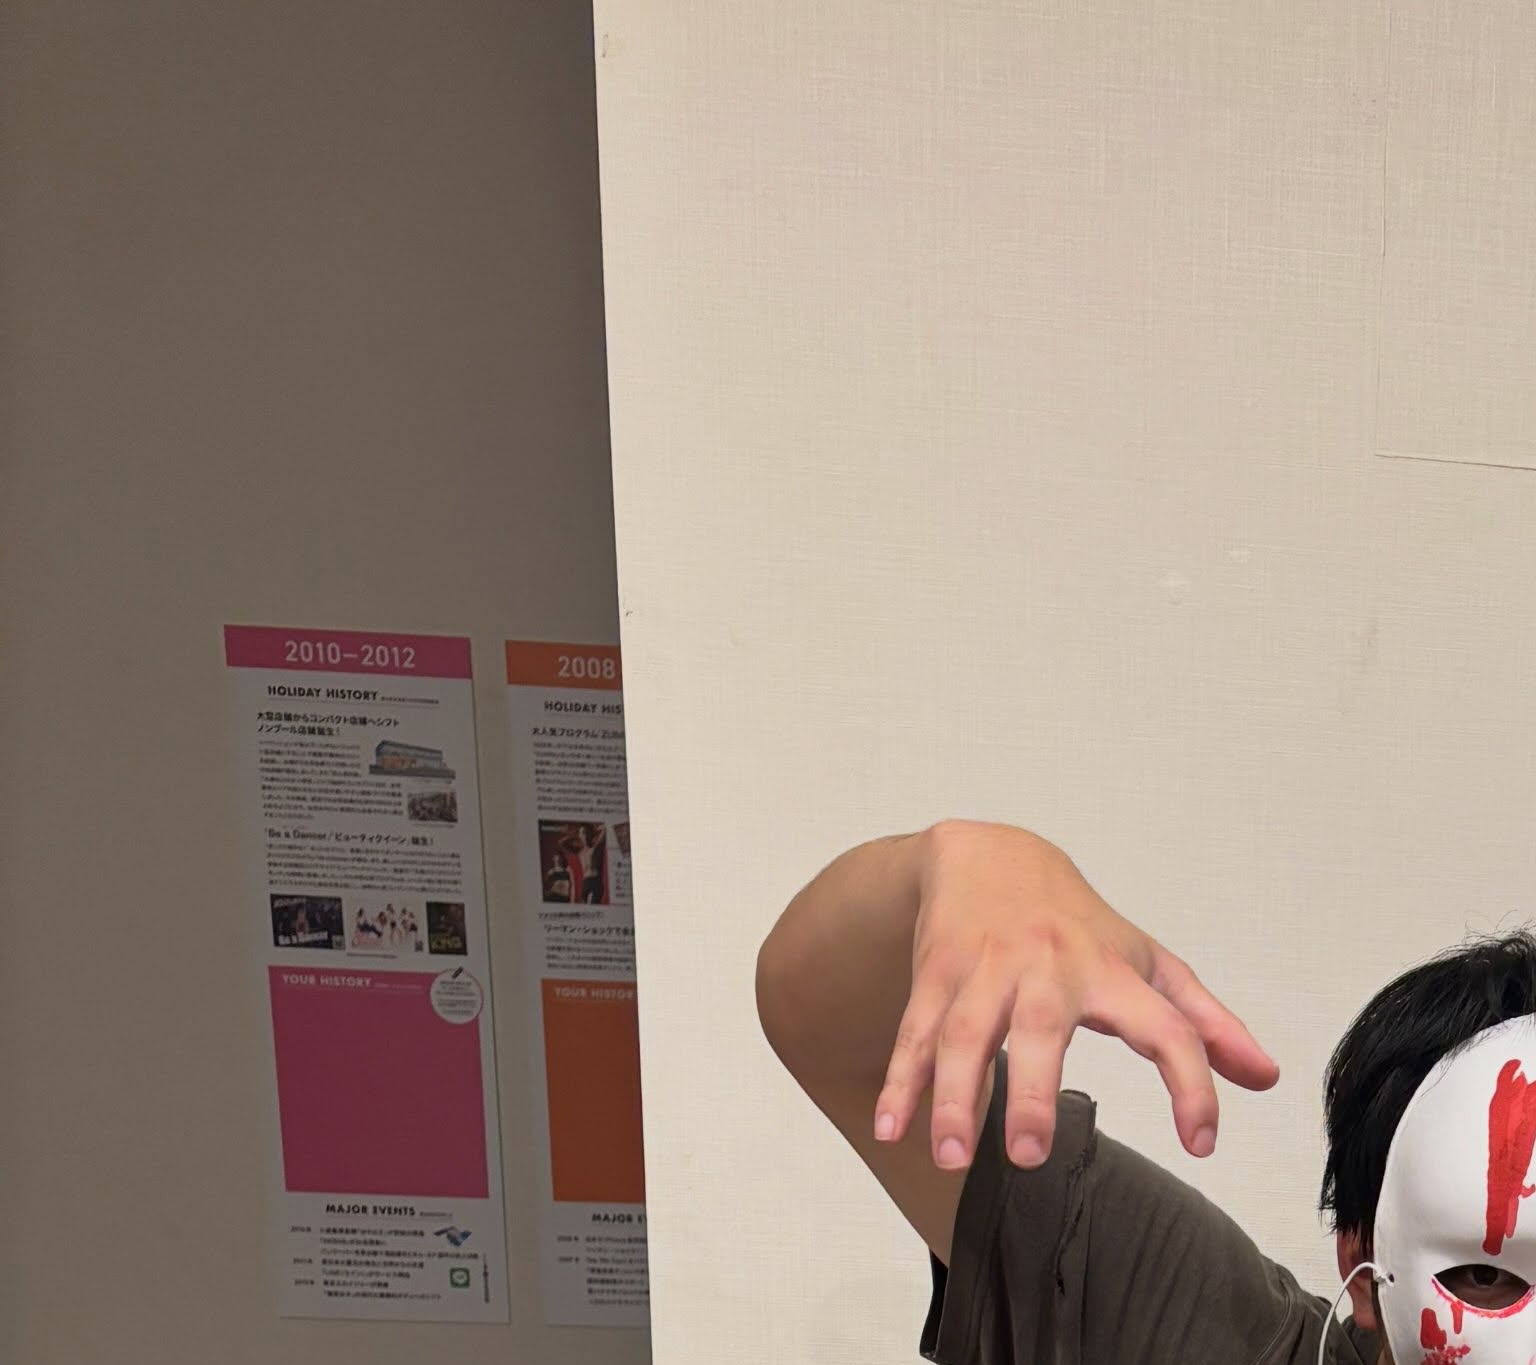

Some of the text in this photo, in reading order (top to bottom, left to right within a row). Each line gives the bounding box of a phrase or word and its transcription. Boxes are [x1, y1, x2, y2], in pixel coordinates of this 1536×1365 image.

[557, 655, 616, 680] 2008
[267, 685, 322, 699] HOLIDAY
[325, 687, 379, 701] HISTORY
[544, 700, 622, 715] HOLIDAY HIS
[282, 974, 315, 986] YOUR
[319, 976, 372, 989] HISTORY
[554, 987, 634, 1000] YOUR HISTOR
[325, 1203, 368, 1216] MAJOR
[372, 1205, 416, 1218] EVENTS
[591, 1213, 632, 1224] MAJOR
